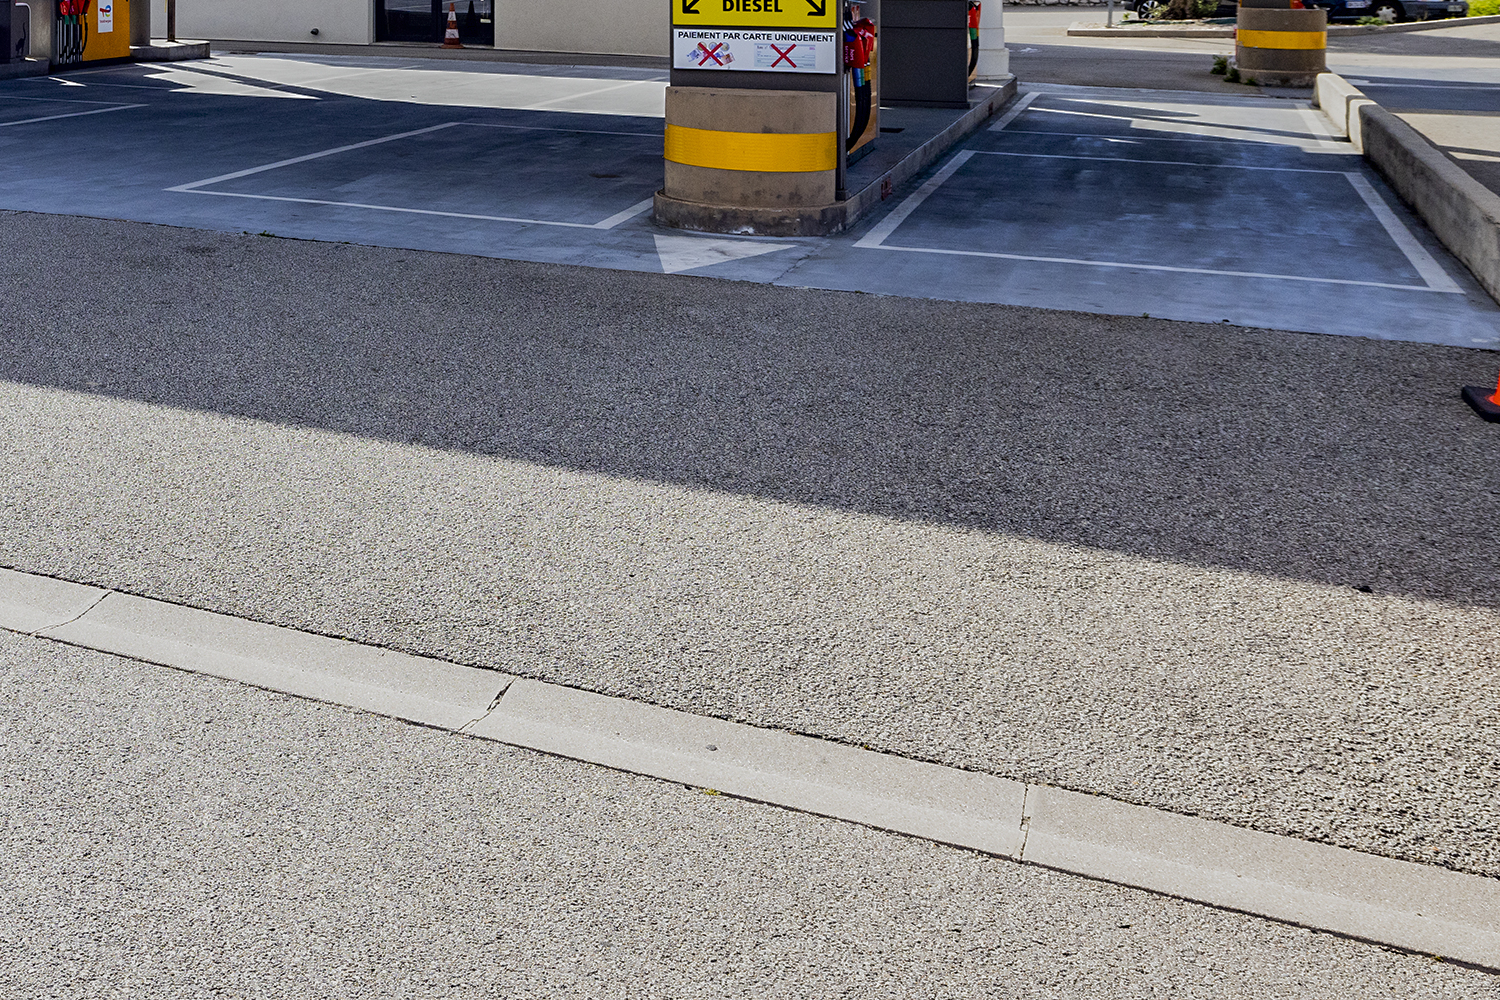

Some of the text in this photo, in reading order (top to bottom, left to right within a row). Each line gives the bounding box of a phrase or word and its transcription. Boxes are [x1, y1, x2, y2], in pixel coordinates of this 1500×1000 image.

[678, 31, 721, 40] PAIEMENT
[742, 33, 773, 41] CARTE
[774, 34, 834, 43] UNIQUEMENT
